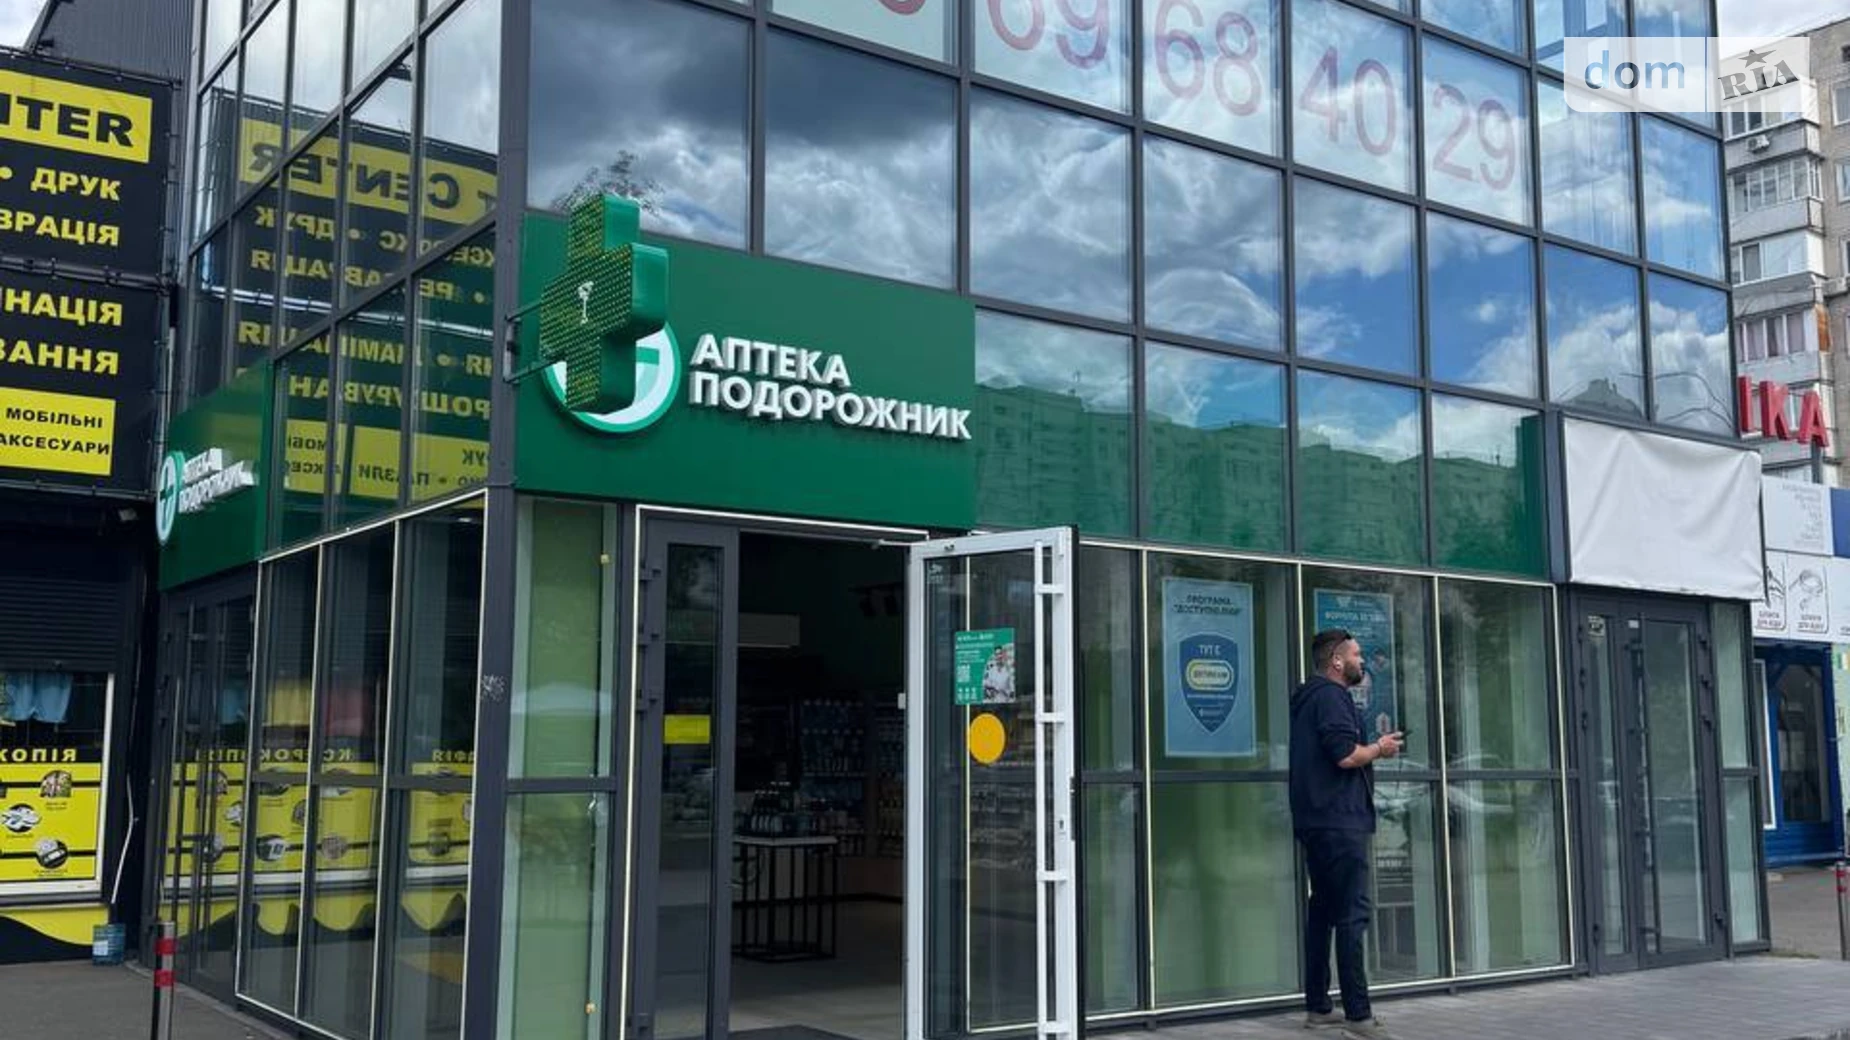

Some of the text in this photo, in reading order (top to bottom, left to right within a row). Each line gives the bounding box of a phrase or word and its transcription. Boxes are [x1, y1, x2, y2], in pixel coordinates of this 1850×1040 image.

[1155, 0, 1262, 117] 68
[1299, 44, 1398, 157] 40
[1431, 83, 1516, 191] 29
[30, 166, 121, 201] ДРУК
[0, 288, 123, 326] НАЦІЯ
[690, 332, 852, 388] АПТЕКА
[6, 406, 104, 428] МОБІЛЬНІ
[688, 370, 973, 441] ПОДОРОЖНИК
